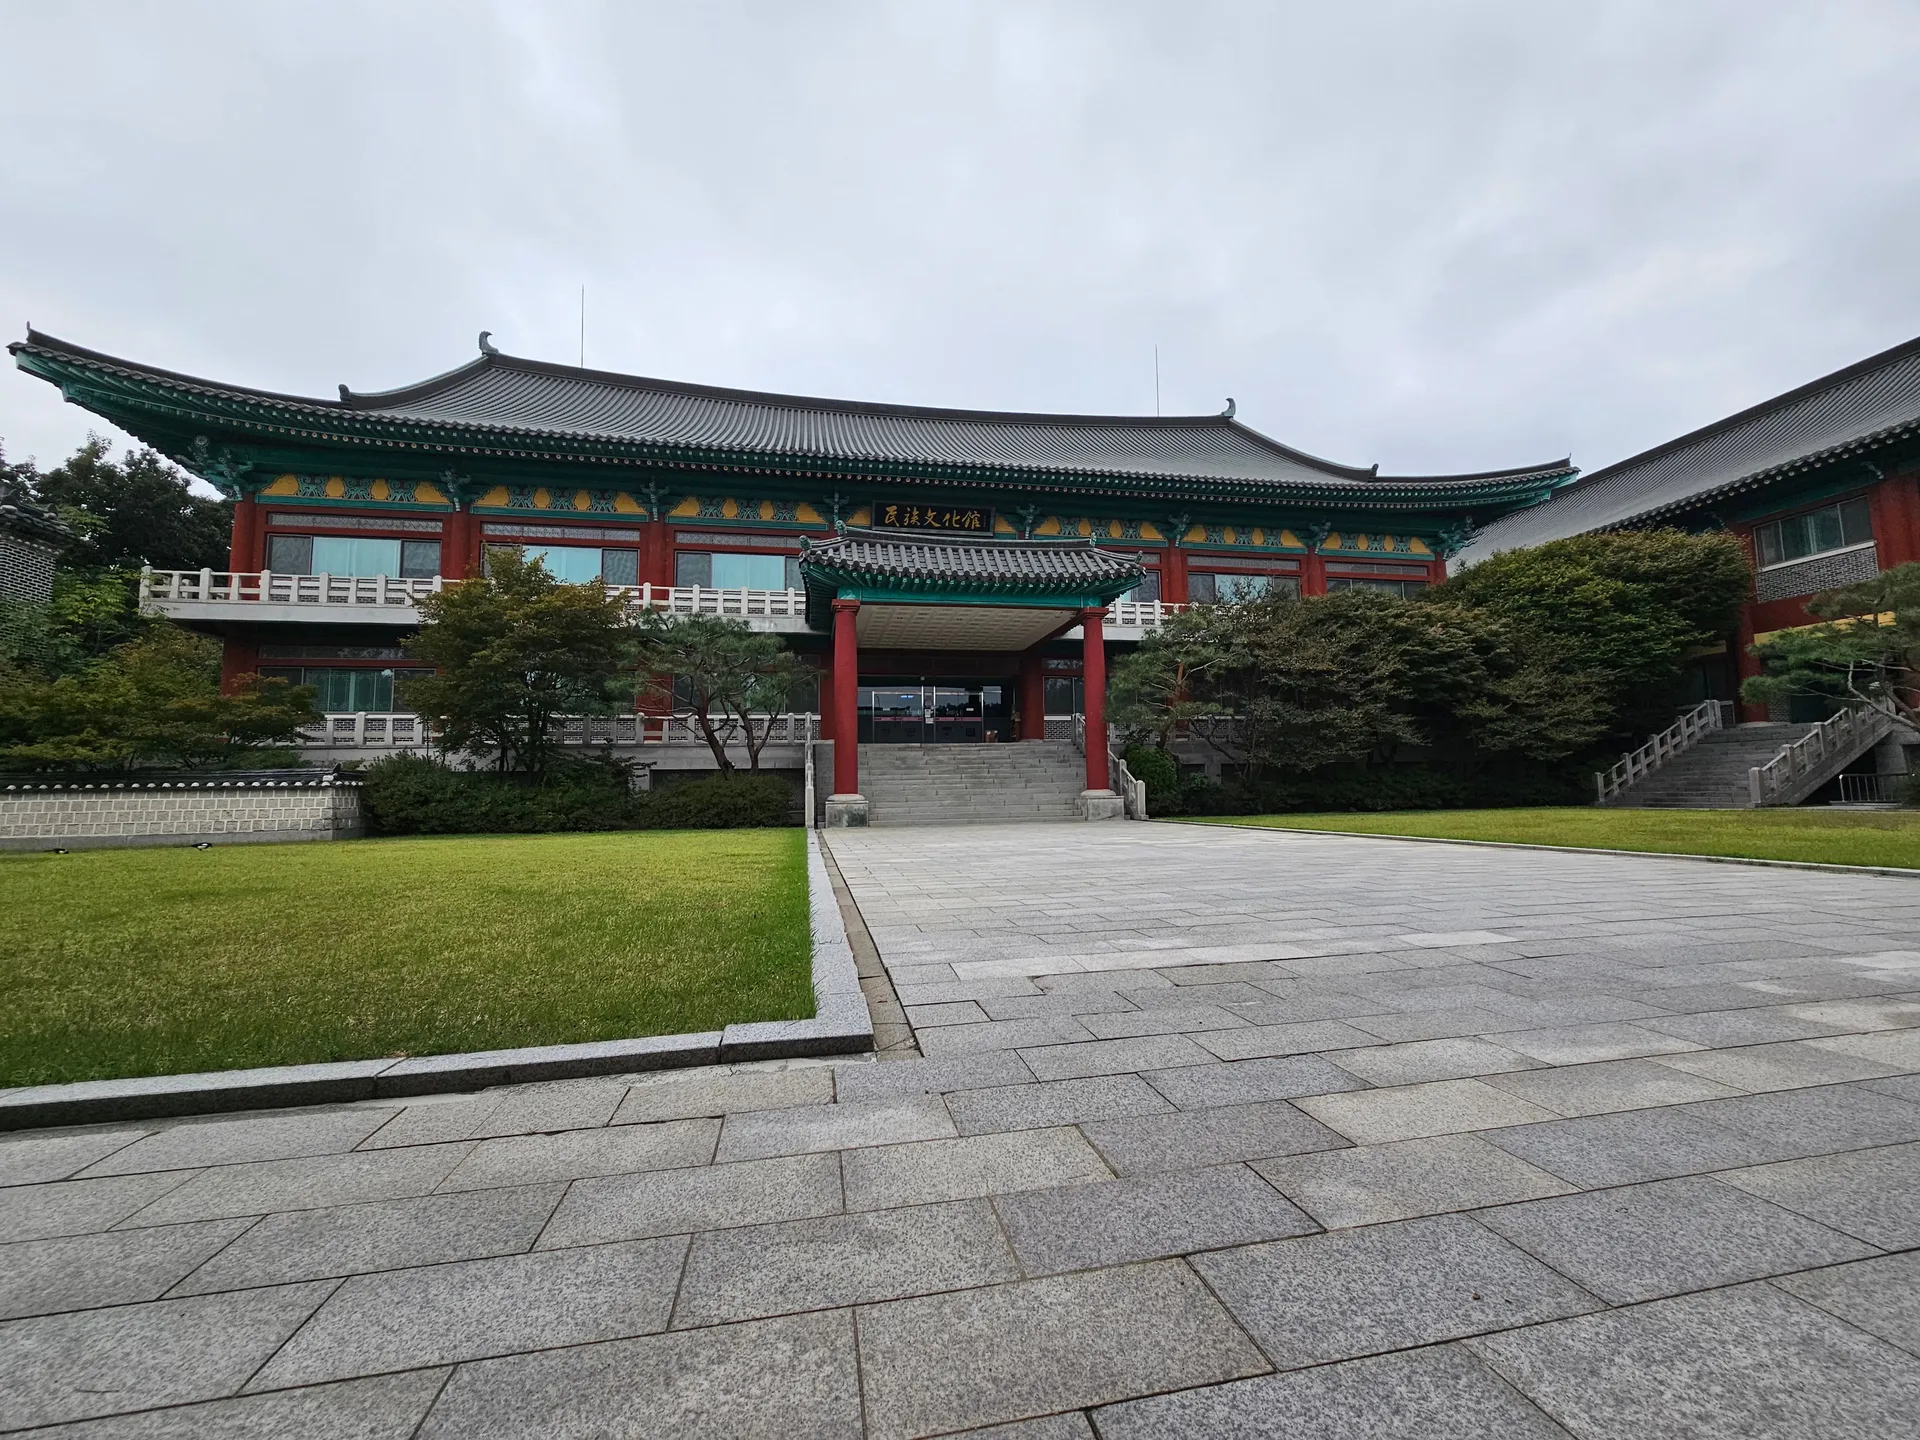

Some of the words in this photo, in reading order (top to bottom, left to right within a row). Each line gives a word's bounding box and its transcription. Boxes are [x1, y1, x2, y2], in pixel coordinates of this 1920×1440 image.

[884, 505, 981, 529] 民族文化館
